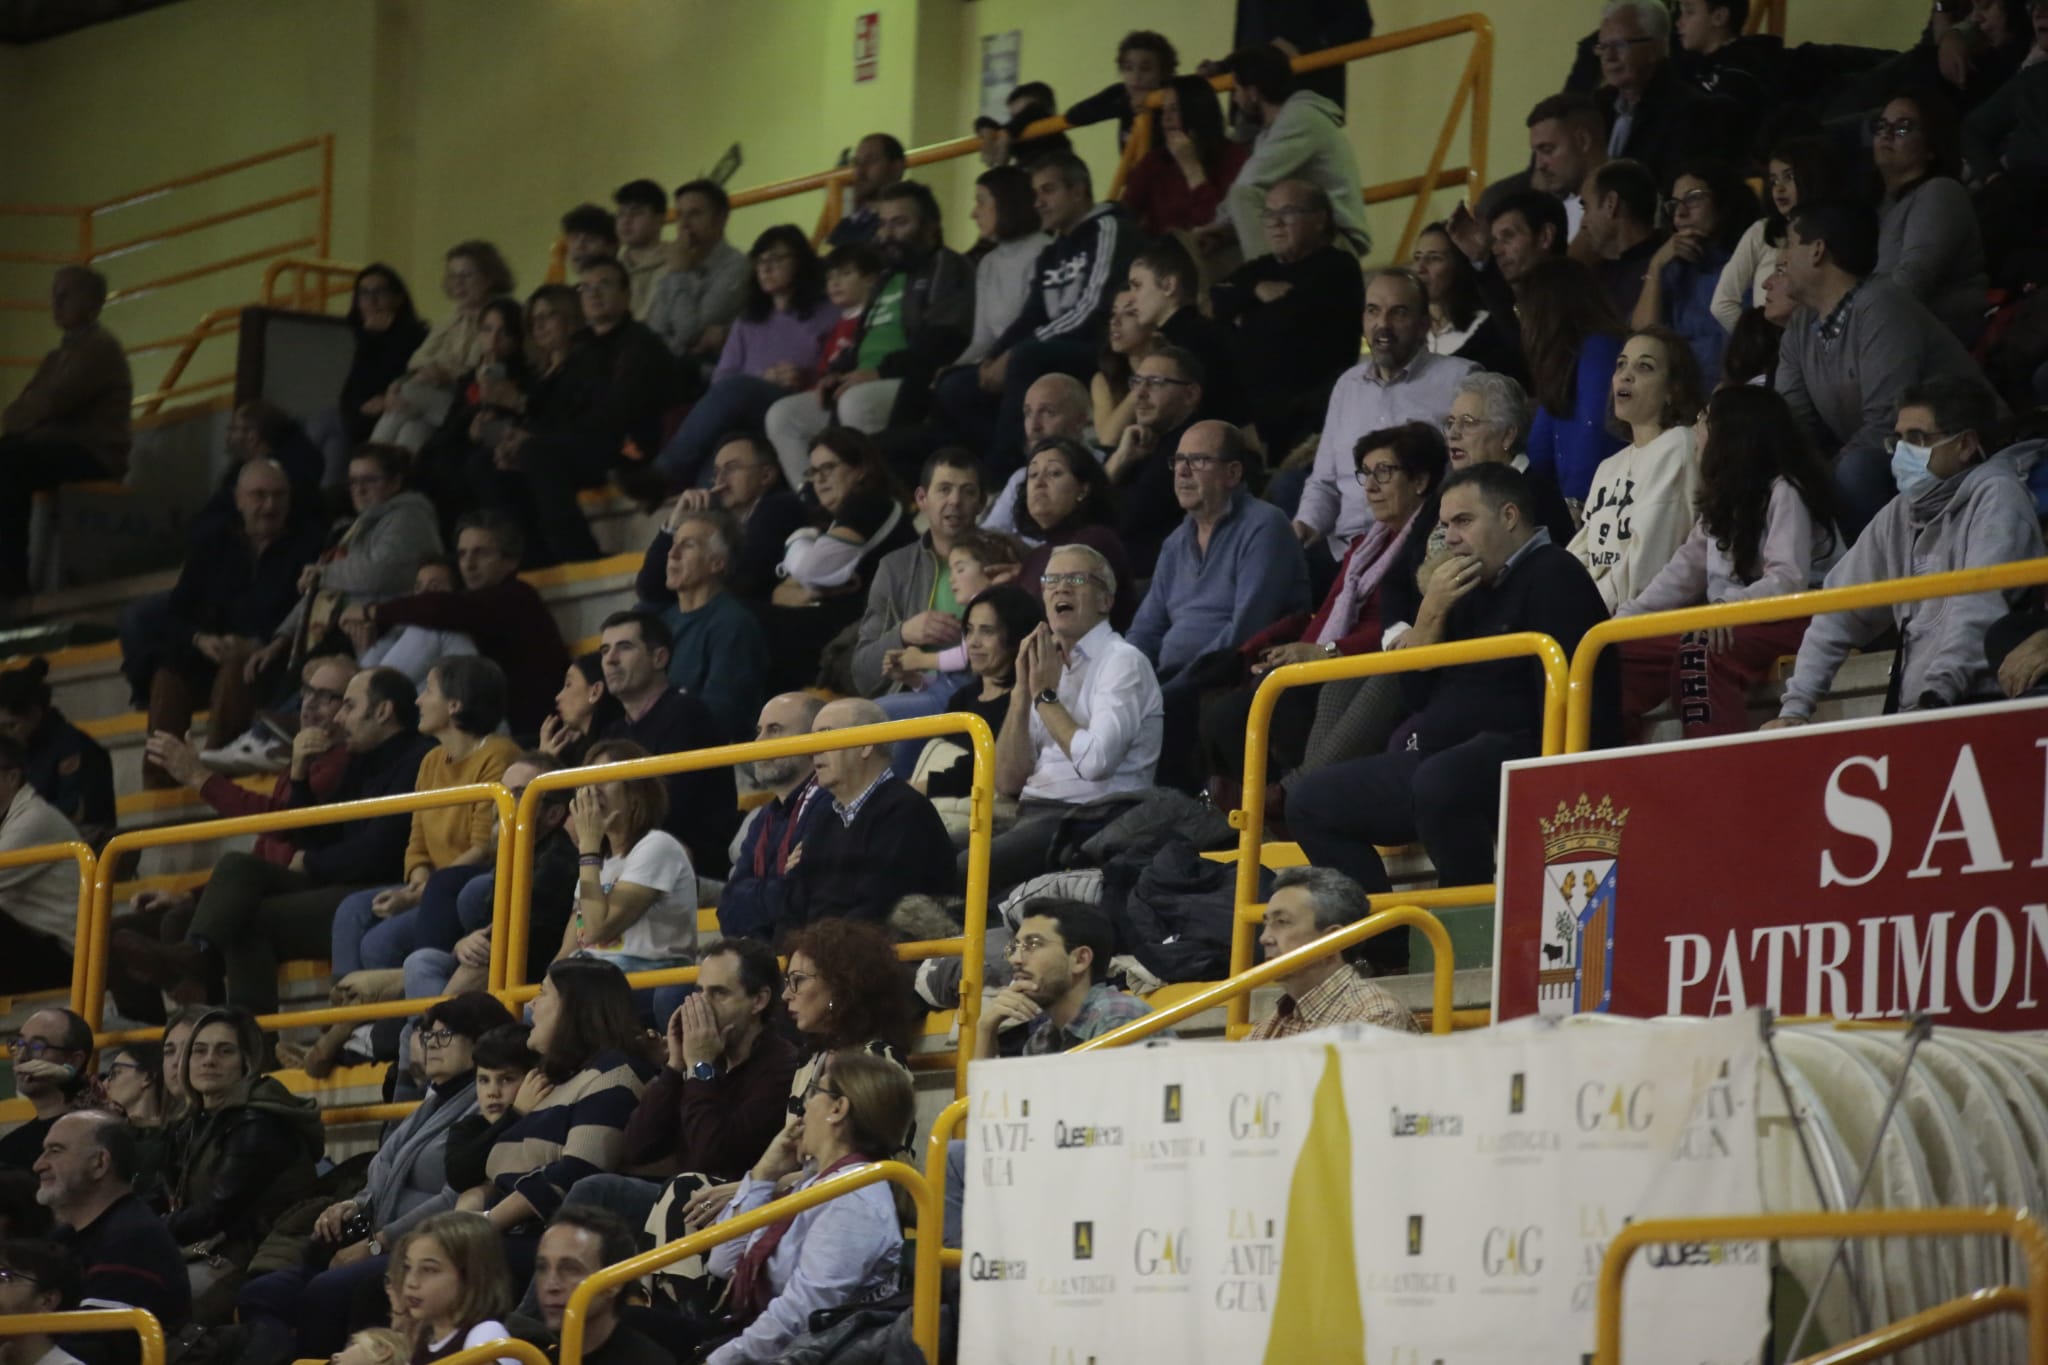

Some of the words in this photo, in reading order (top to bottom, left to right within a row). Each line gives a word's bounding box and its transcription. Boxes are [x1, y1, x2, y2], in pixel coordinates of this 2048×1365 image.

[1229, 1091, 1282, 1140] GAG
[1576, 1080, 1655, 1133] GAG
[1133, 1226, 1193, 1277] GAG
[1219, 1244, 1280, 1276] ANTI-
[1482, 1225, 1543, 1278] GAG
[1215, 1280, 1267, 1312] GUA
